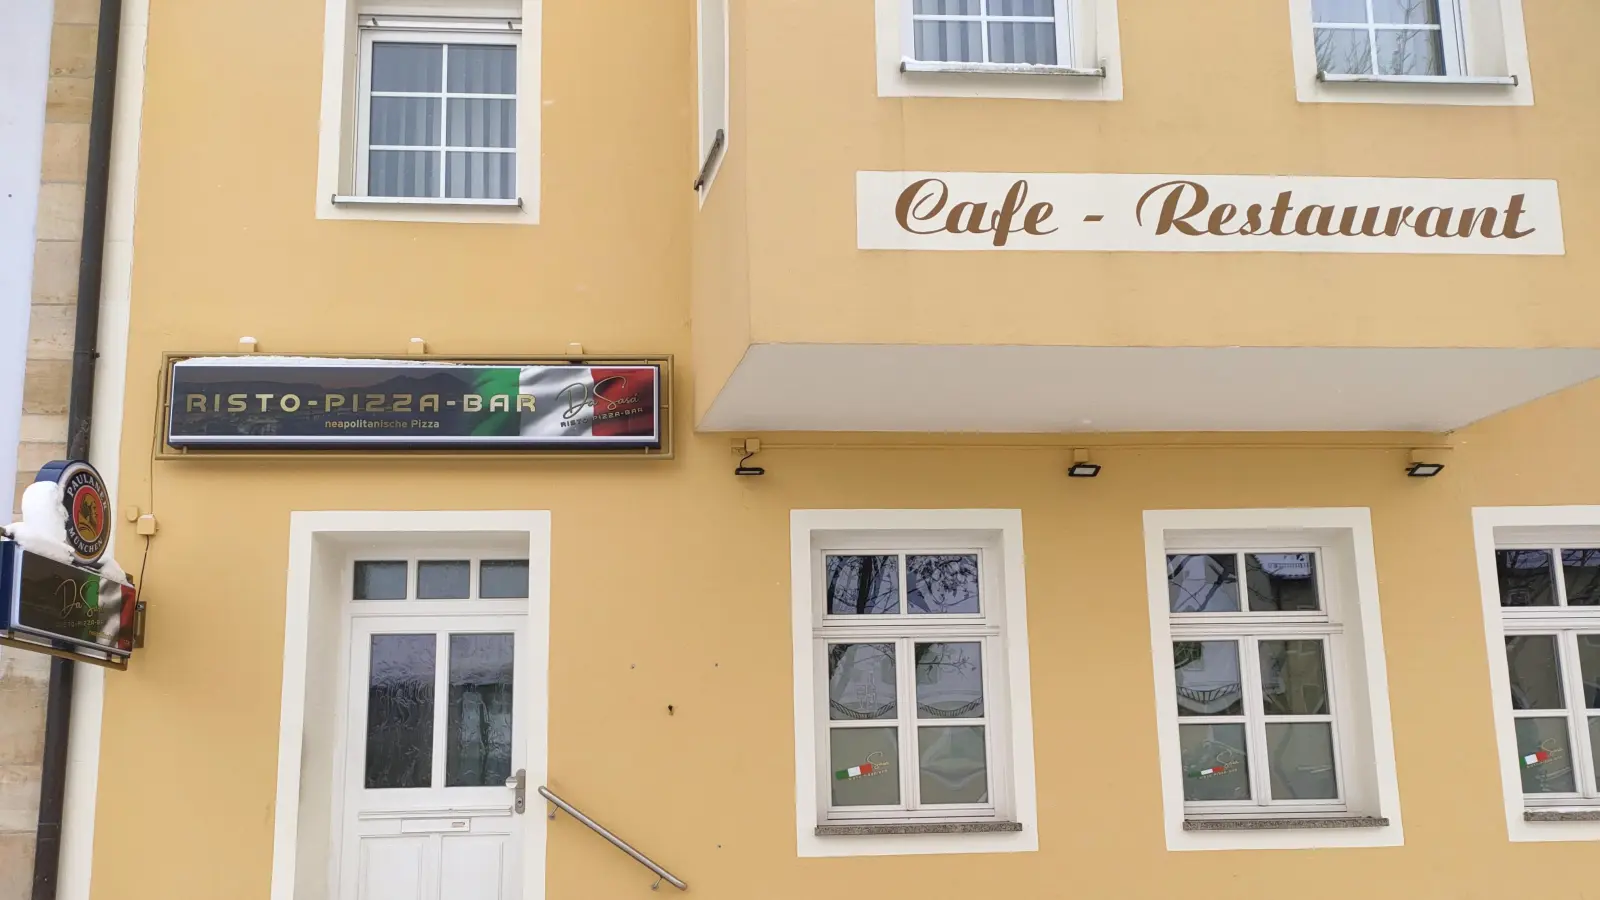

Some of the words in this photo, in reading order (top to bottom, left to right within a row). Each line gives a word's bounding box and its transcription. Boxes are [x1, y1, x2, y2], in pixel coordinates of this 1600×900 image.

[895, 178, 1059, 247] Cafe
[1136, 180, 1536, 239] Restaurant
[186, 393, 537, 413] RISTO-PIZZA-BAR
[324, 418, 408, 430] neapolitanische
[411, 418, 440, 428] Pizza
[560, 407, 643, 428] RISTOPIZZA-BAR
[67, 473, 107, 511] PAULANER
